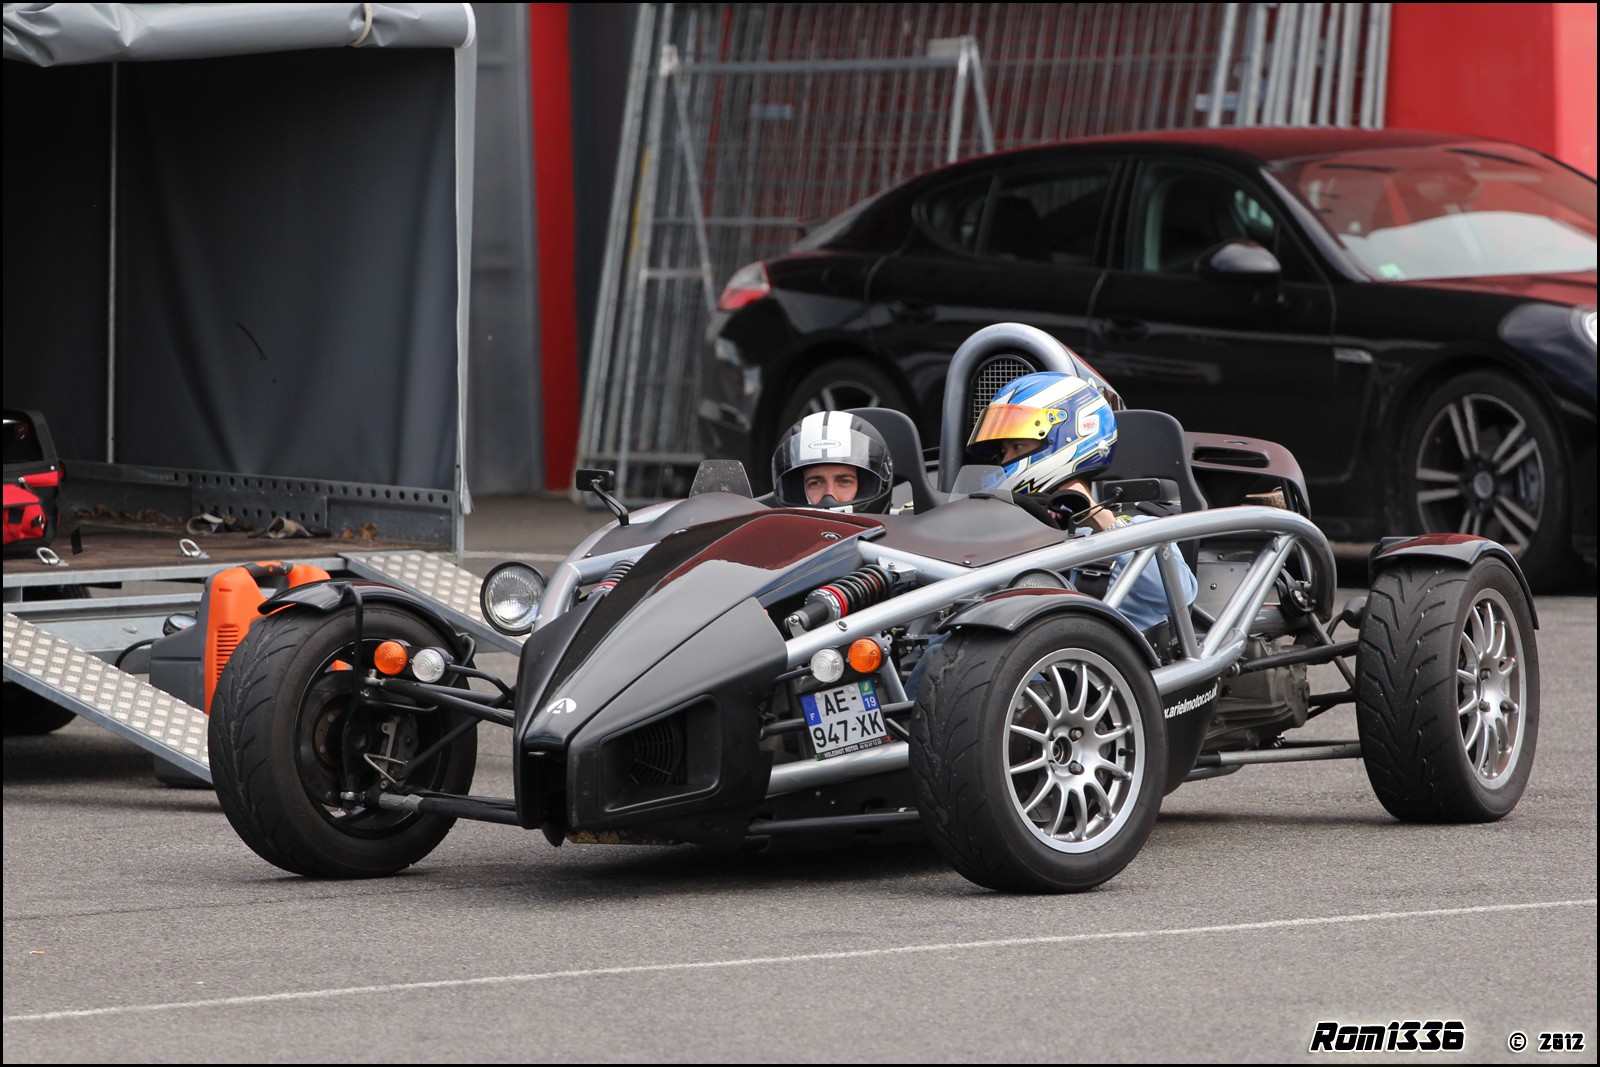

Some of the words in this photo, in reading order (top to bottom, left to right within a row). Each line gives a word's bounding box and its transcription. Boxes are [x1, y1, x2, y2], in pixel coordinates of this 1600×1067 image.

[864, 696, 877, 708] 19
[810, 712, 815, 721] F
[812, 711, 884, 748] 947-XK
[844, 744, 859, 754] MOTOS
